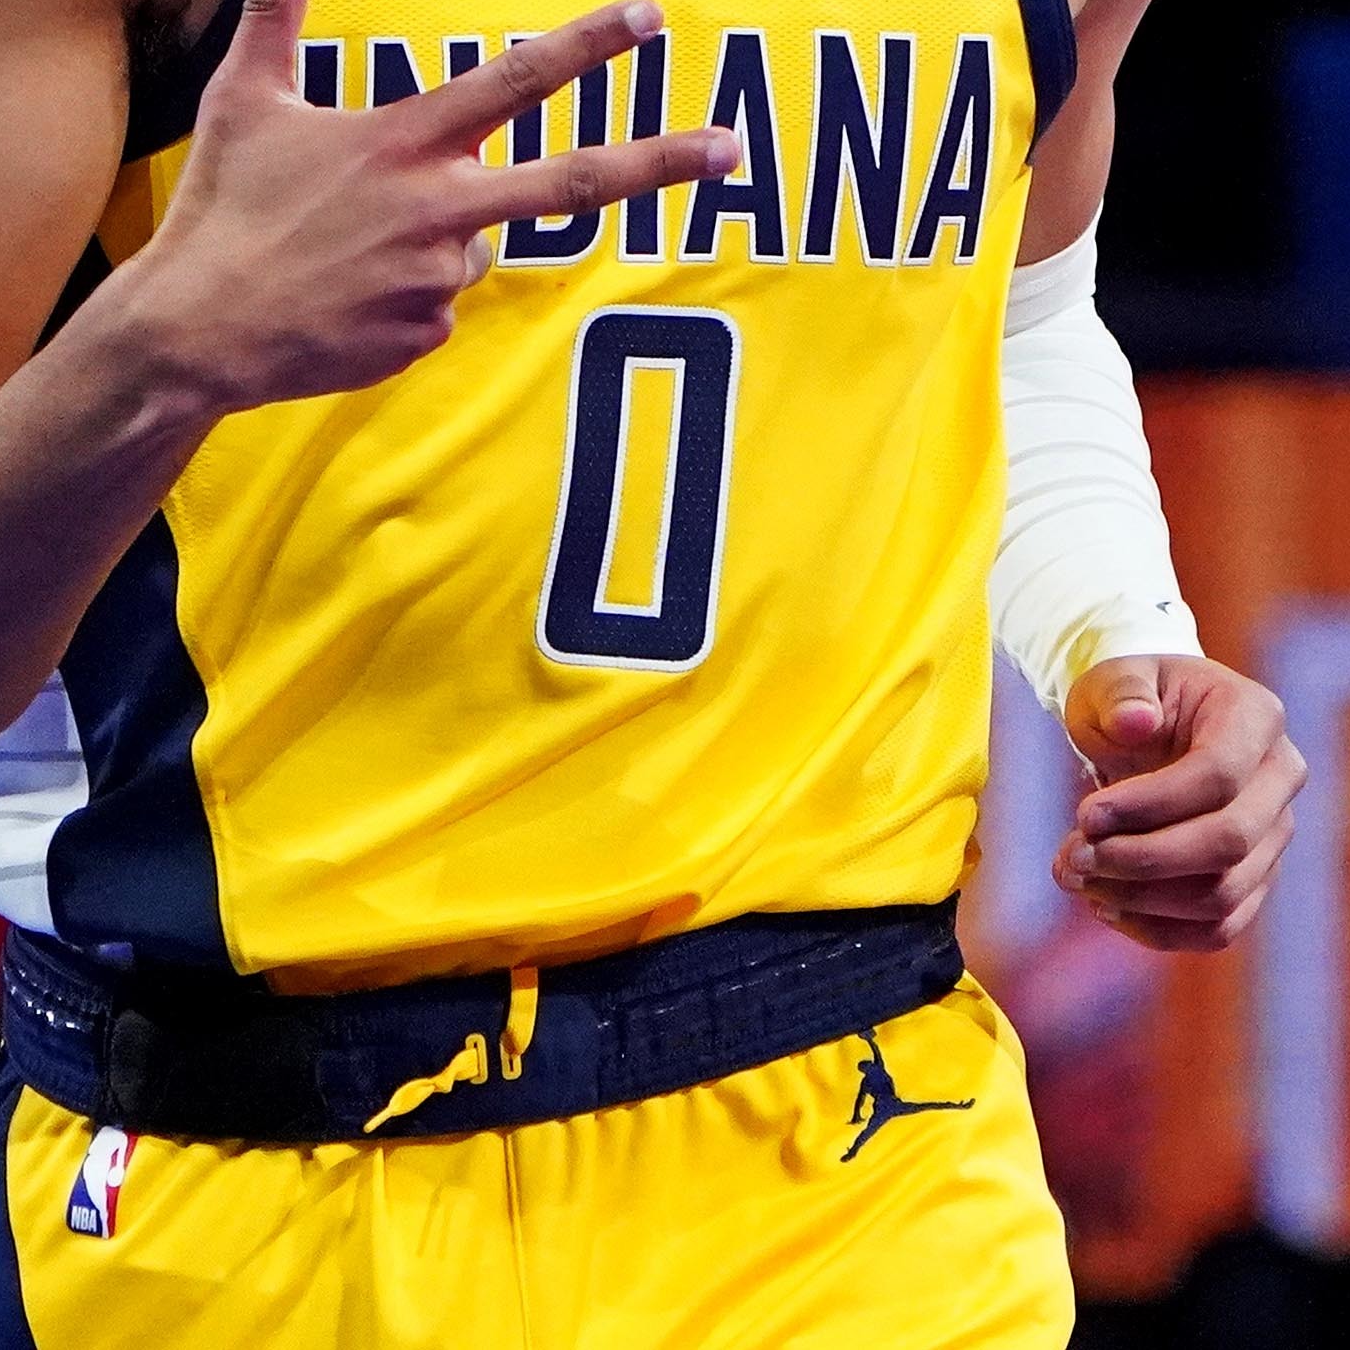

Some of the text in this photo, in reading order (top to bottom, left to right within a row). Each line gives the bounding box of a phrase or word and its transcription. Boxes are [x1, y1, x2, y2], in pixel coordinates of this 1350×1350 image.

[296, 27, 996, 266] DIANA
[535, 303, 742, 673] 0
[71, 1205, 98, 1233] NBA
